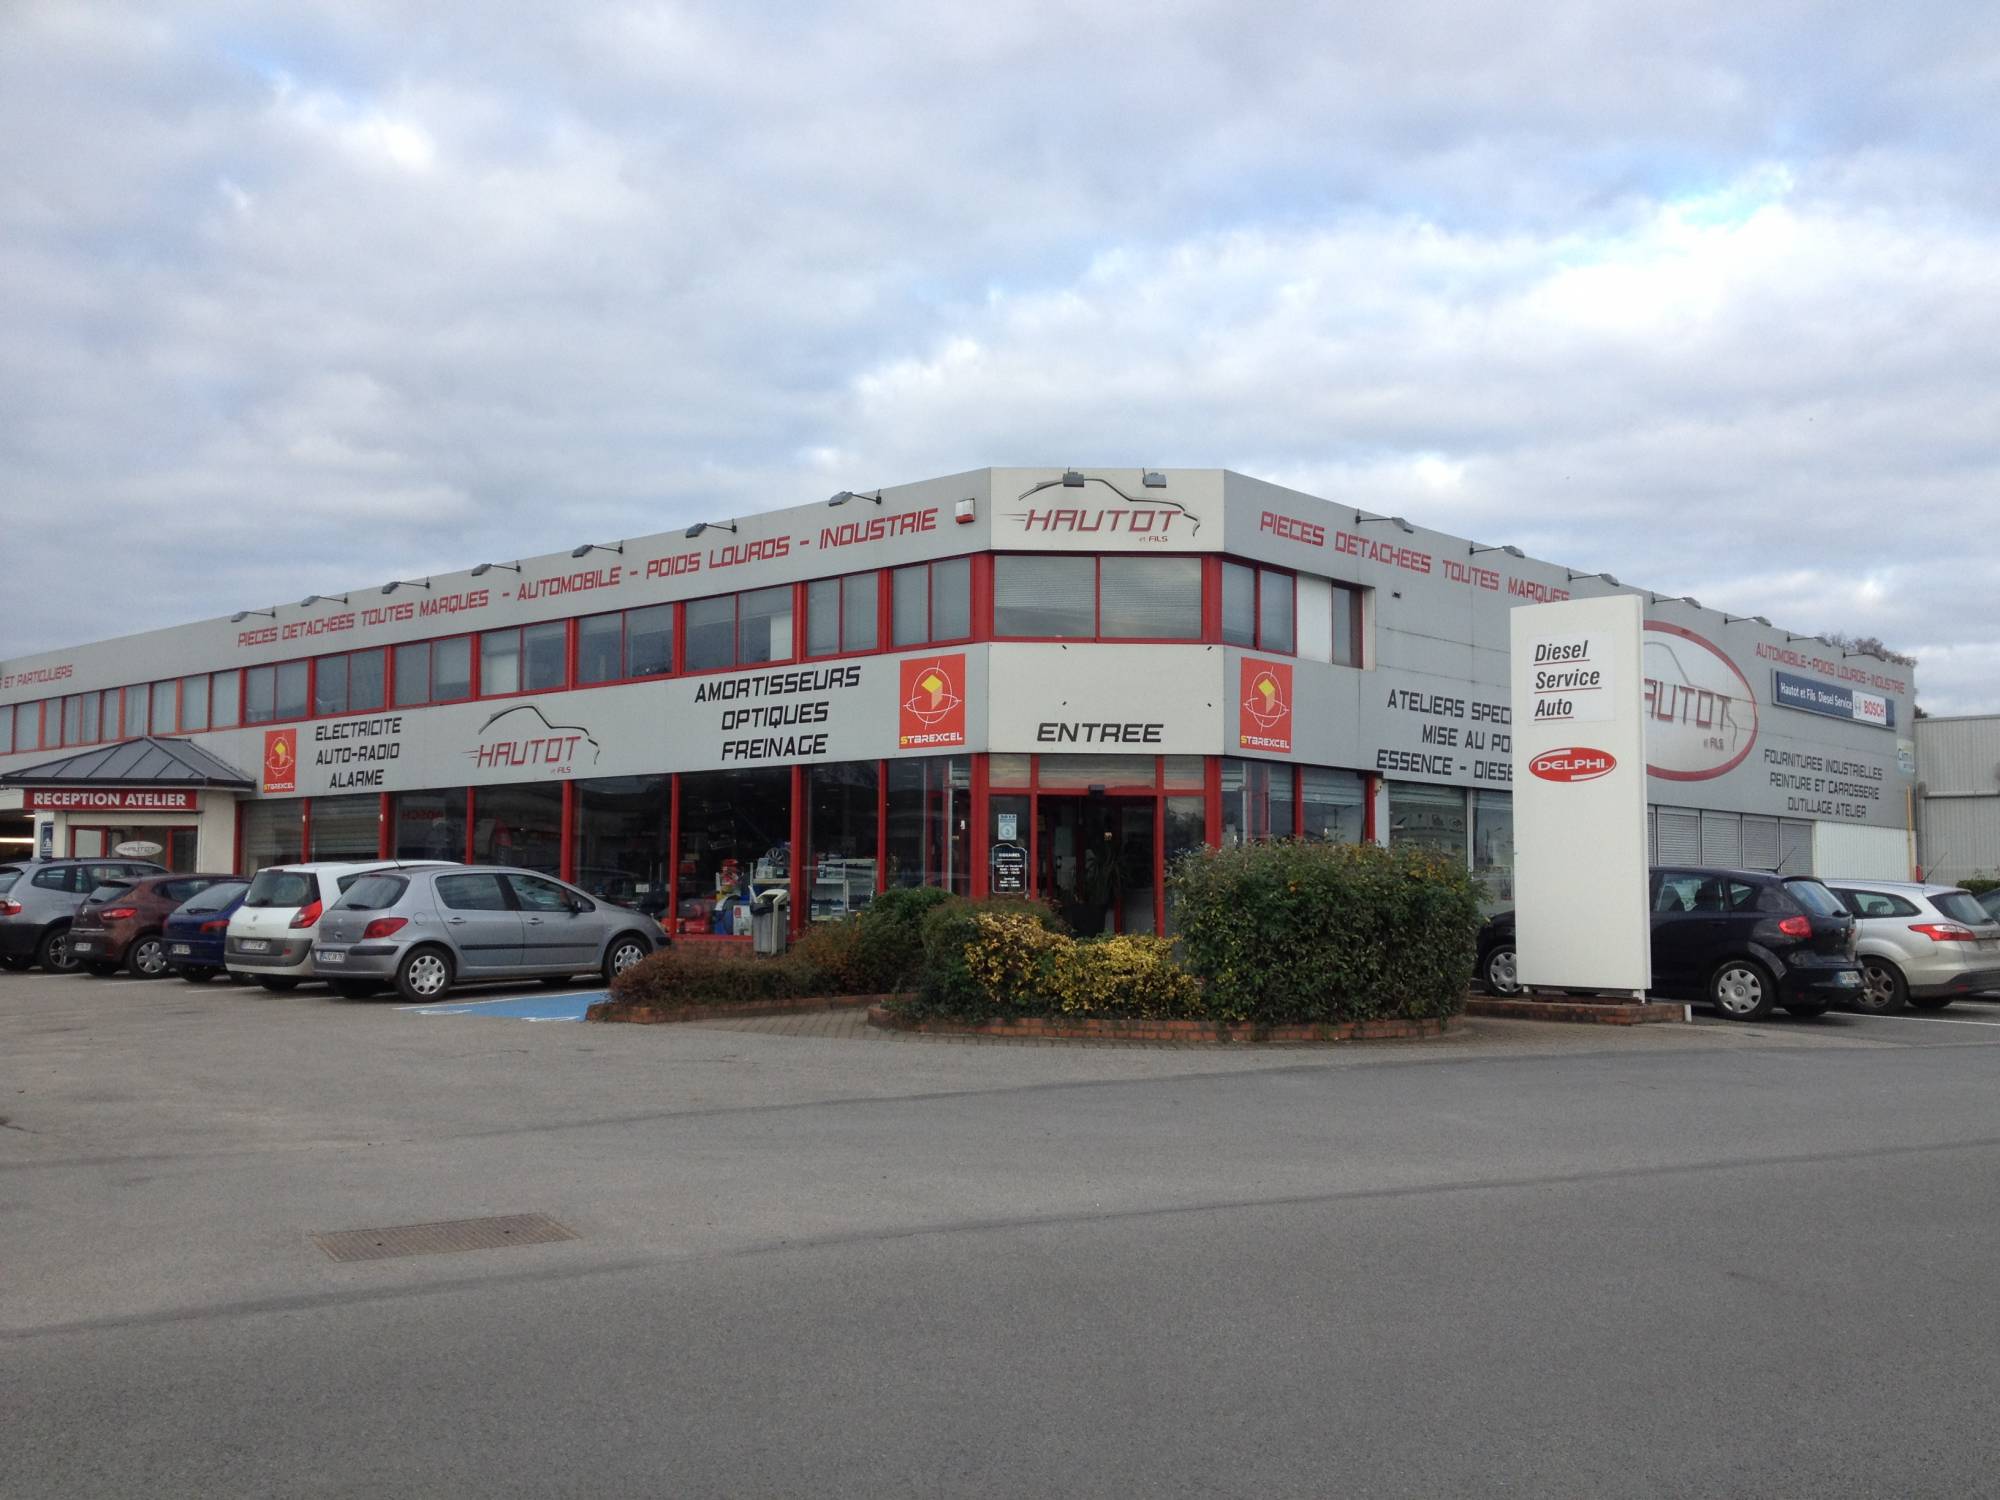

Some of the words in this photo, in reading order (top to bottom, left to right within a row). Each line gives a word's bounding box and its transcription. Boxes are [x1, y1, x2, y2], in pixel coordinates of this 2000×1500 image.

[1025, 509, 1182, 532] HAUTOT
[1260, 511, 1325, 547] PIECES
[1335, 531, 1431, 574] DETACHEES
[1442, 559, 1500, 591] TOUTES
[238, 627, 277, 647] PIECES
[282, 613, 355, 639] DETACHEES
[361, 603, 414, 627] TOUTES
[419, 589, 489, 616] MARQUES
[517, 566, 622, 600] AUTOMOBILE
[646, 552, 701, 579] POIDS
[709, 536, 790, 568] LOURDS
[819, 507, 938, 549] INDUSTRIE
[1535, 640, 1589, 662] Diesel
[1755, 642, 1807, 669] AUTOMOBILE
[4, 676, 14, 688] ET
[694, 665, 861, 703] AMORTISSEURS
[1535, 668, 1600, 689] Service
[1387, 689, 1465, 718] ATELIERS
[1535, 698, 1573, 717] Auto
[1644, 678, 1731, 731] AUTOT
[1780, 682, 1799, 697] Hautot
[1800, 688, 1806, 699] et
[1806, 688, 1816, 702] Fils
[1818, 691, 1834, 706] Diesel
[1834, 695, 1853, 710] Service
[1863, 700, 1885, 717] BOSCH
[721, 701, 829, 730] OPTIQUES
[315, 717, 402, 741] ELECTRICITE
[1037, 722, 1164, 743] ENTREE
[1422, 724, 1458, 747] MISE
[1465, 730, 1485, 750] AU
[316, 743, 400, 765] AUTO-RADIO
[477, 736, 581, 768] HAUTOT
[721, 733, 829, 761] FREINAGE
[1376, 749, 1453, 776] ESSENCE
[1537, 758, 1607, 771] DELPHI
[1764, 749, 1823, 772] FOURNITURES
[1826, 759, 1883, 781] INDUSTRIELLES
[329, 769, 384, 788] ALARME
[1769, 772, 1812, 791] PEINTURE
[1815, 778, 1825, 793] ET
[1828, 780, 1880, 800] CARROSSERIE
[33, 792, 120, 806] RECEPTION
[125, 793, 186, 806] ATELIER
[1788, 797, 1832, 815] OUTILLAGE
[1836, 802, 1866, 818] ATELIER
